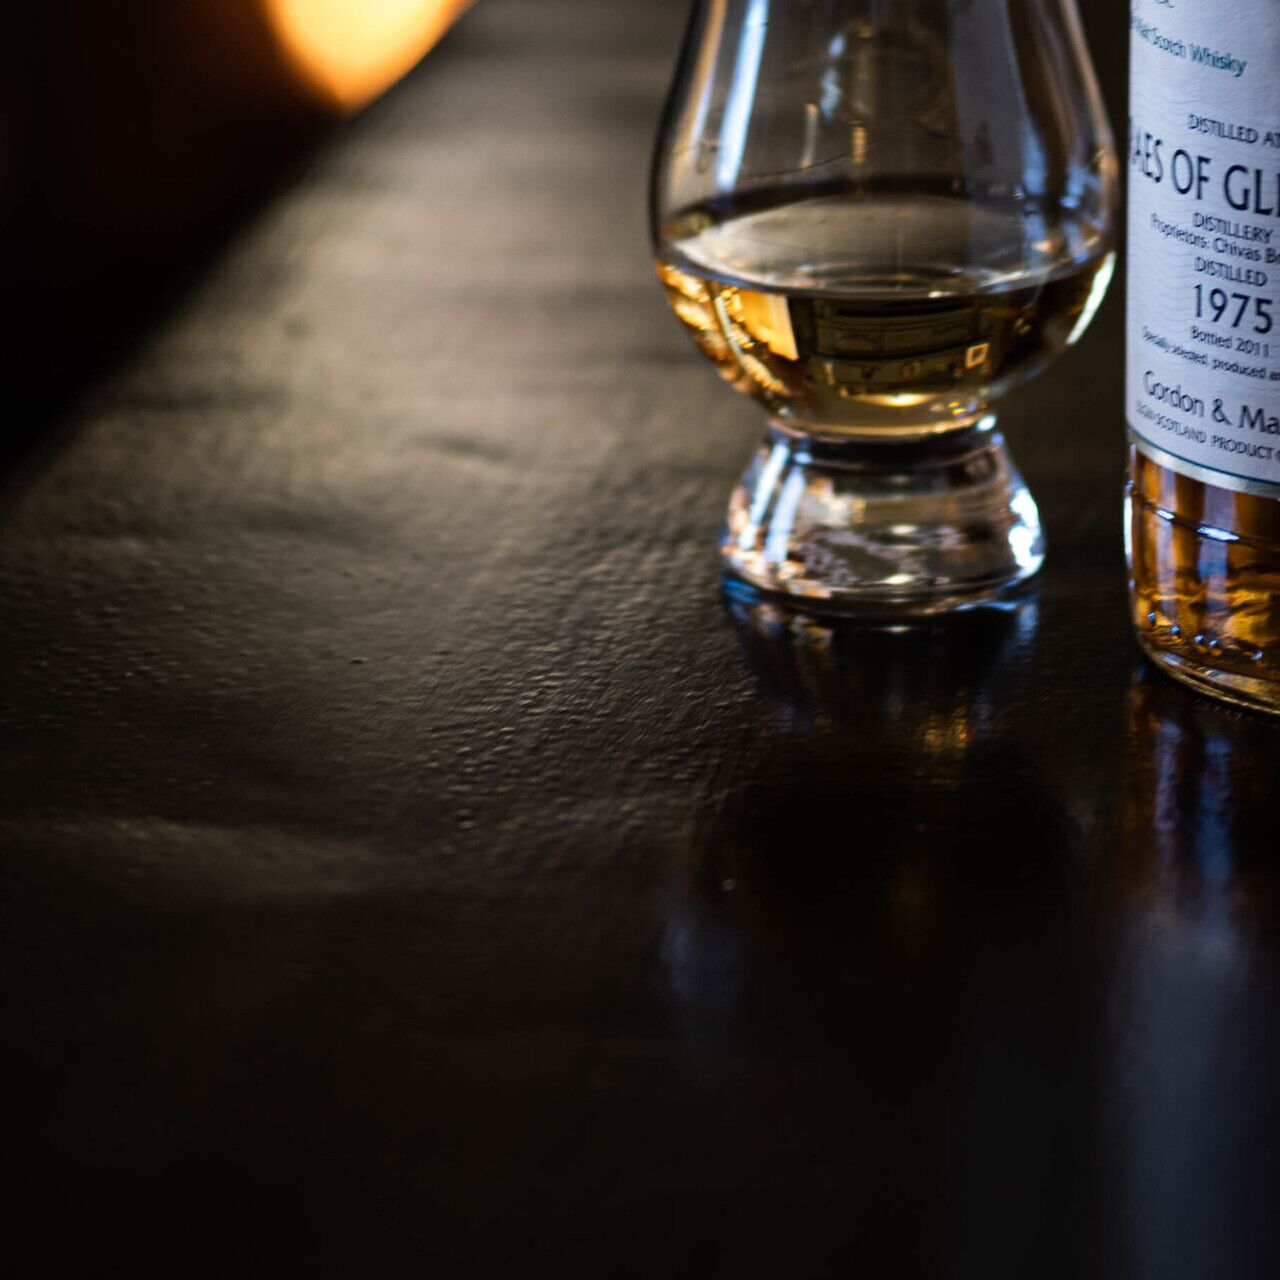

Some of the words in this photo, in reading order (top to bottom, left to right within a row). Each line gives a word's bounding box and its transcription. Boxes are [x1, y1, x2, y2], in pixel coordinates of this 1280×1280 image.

[1187, 43, 1248, 78] Whisky
[1187, 113, 1258, 145] DISTILLED
[1171, 148, 1212, 200] OF
[1192, 211, 1274, 244] DISTILLERY
[1212, 236, 1262, 262] Chivas
[1193, 255, 1269, 288] DISTILLED
[1193, 282, 1274, 335] 1975
[1190, 325, 1234, 350] Bottled
[1235, 337, 1270, 358] 2011
[1211, 358, 1267, 380] produced
[1143, 370, 1205, 418] Gordon
[1211, 398, 1232, 426] &
[1210, 434, 1274, 463] PRODUCT
